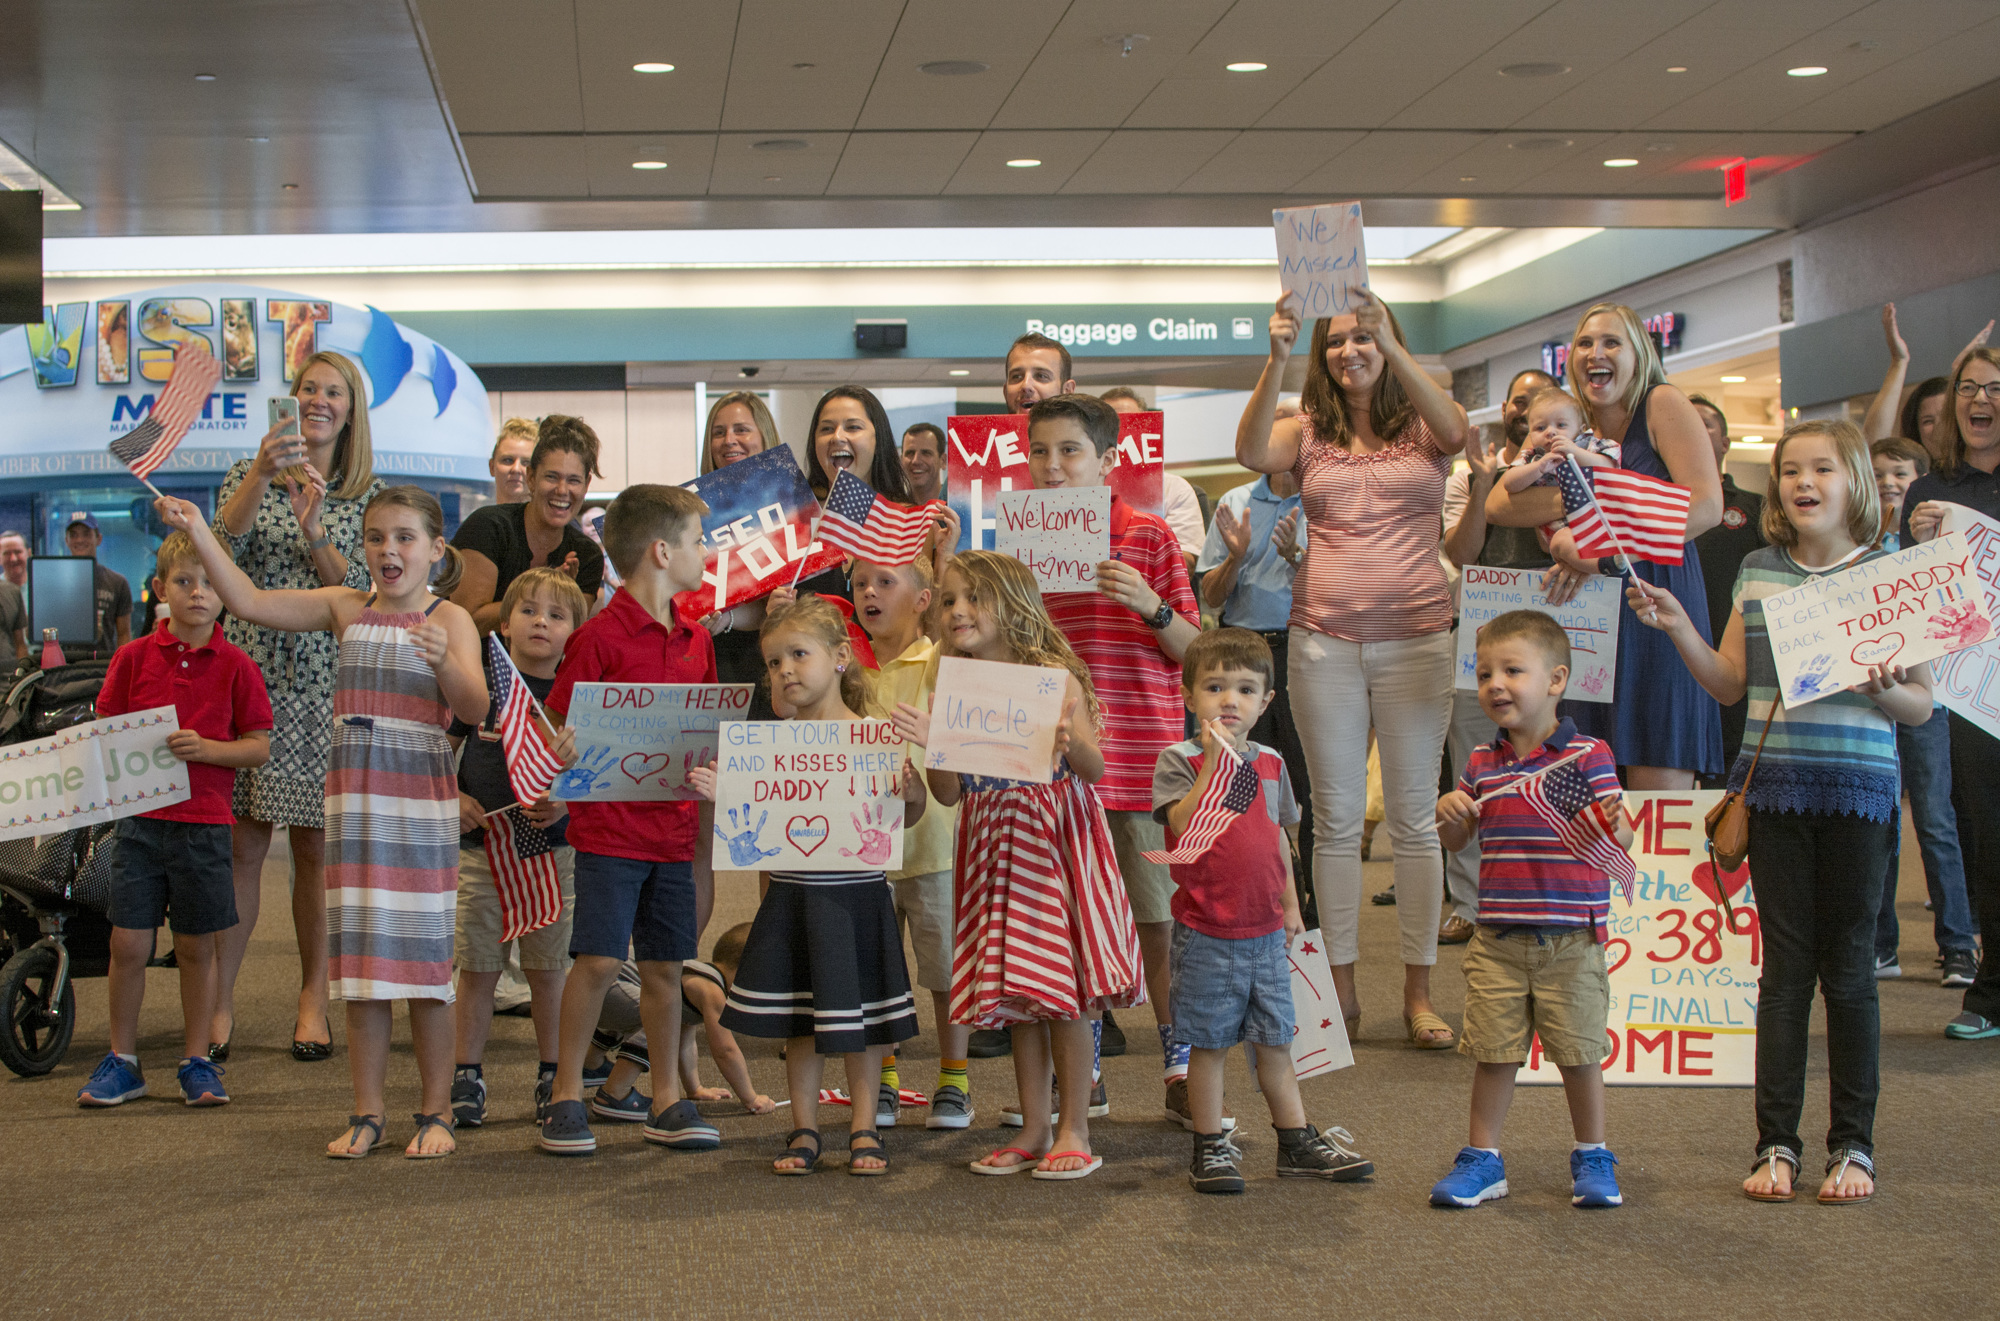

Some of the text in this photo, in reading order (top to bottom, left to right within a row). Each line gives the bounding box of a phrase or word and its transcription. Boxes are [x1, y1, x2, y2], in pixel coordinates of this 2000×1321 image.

[1290, 209, 1338, 245] We
[1292, 281, 1353, 318] YOU
[24, 298, 333, 389] VISIT
[1026, 318, 1218, 346] Baggage Claim
[111, 392, 247, 422] MTE
[187, 420, 248, 431] ORATORY
[45, 455, 72, 472] OF
[75, 453, 119, 471] THE
[165, 451, 234, 470] ASOTA
[948, 428, 1163, 468] WEME
[372, 453, 458, 473] MMUNITY
[702, 502, 788, 551] SED
[1002, 494, 1102, 535] Welcome
[1466, 568, 1521, 586] DADDY
[1766, 578, 1841, 612] OUTTA
[1848, 561, 1881, 583] MY
[1465, 589, 1523, 604] WAITING
[1774, 554, 1969, 631] I GET MY DADDY
[1464, 608, 1504, 620] NEAR
[1778, 630, 1826, 655] BACK
[1859, 642, 1898, 660] James
[574, 687, 750, 710] MY DAD MY HERO
[573, 713, 747, 731] IS COMING HOM
[947, 694, 1034, 738] Uncle
[727, 722, 904, 746] GET YOUR HUGS
[0, 744, 178, 805] ome Joe
[629, 762, 653, 772] JOE
[727, 752, 901, 773] AND KISSES HERE
[755, 779, 829, 802] DADDY
[1636, 869, 1693, 902] the
[1609, 904, 1760, 966] ter 389
[1626, 994, 1759, 1026] FINALLY
[1530, 1028, 1714, 1077] OME
